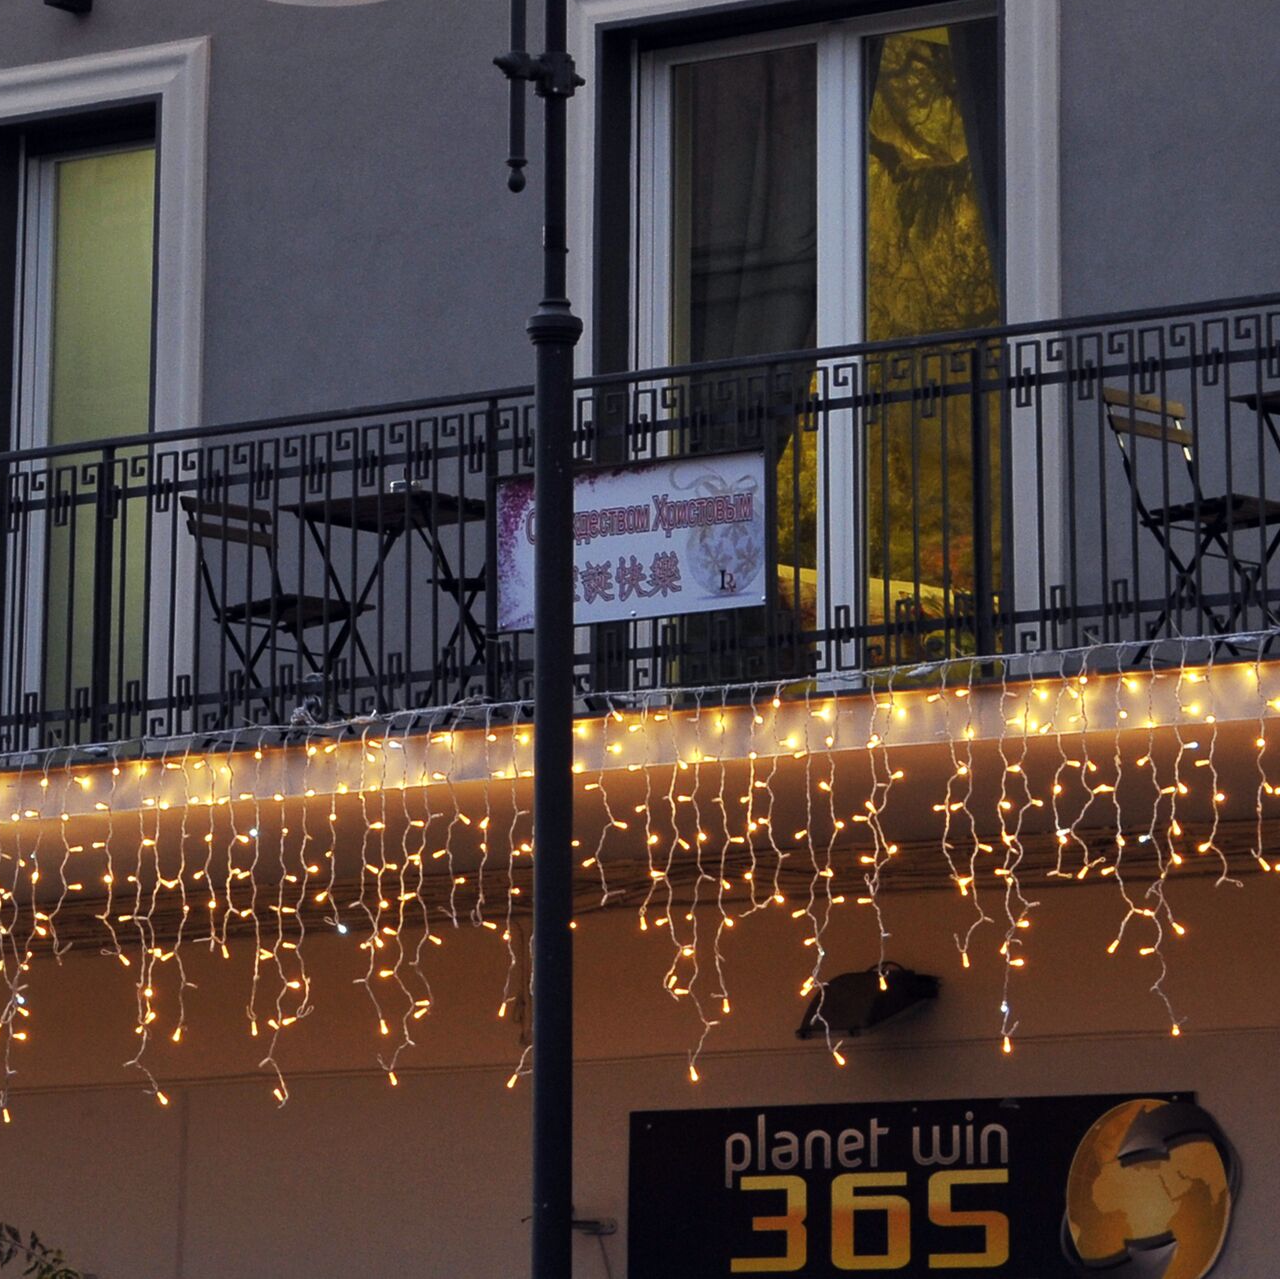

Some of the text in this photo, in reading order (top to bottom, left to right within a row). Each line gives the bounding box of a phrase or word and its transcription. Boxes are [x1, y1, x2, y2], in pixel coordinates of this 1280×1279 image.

[652, 493, 754, 538] Христовым
[573, 551, 682, 605] 誕快樂
[724, 1111, 1010, 1189] planet win
[730, 1168, 1010, 1273] 365
